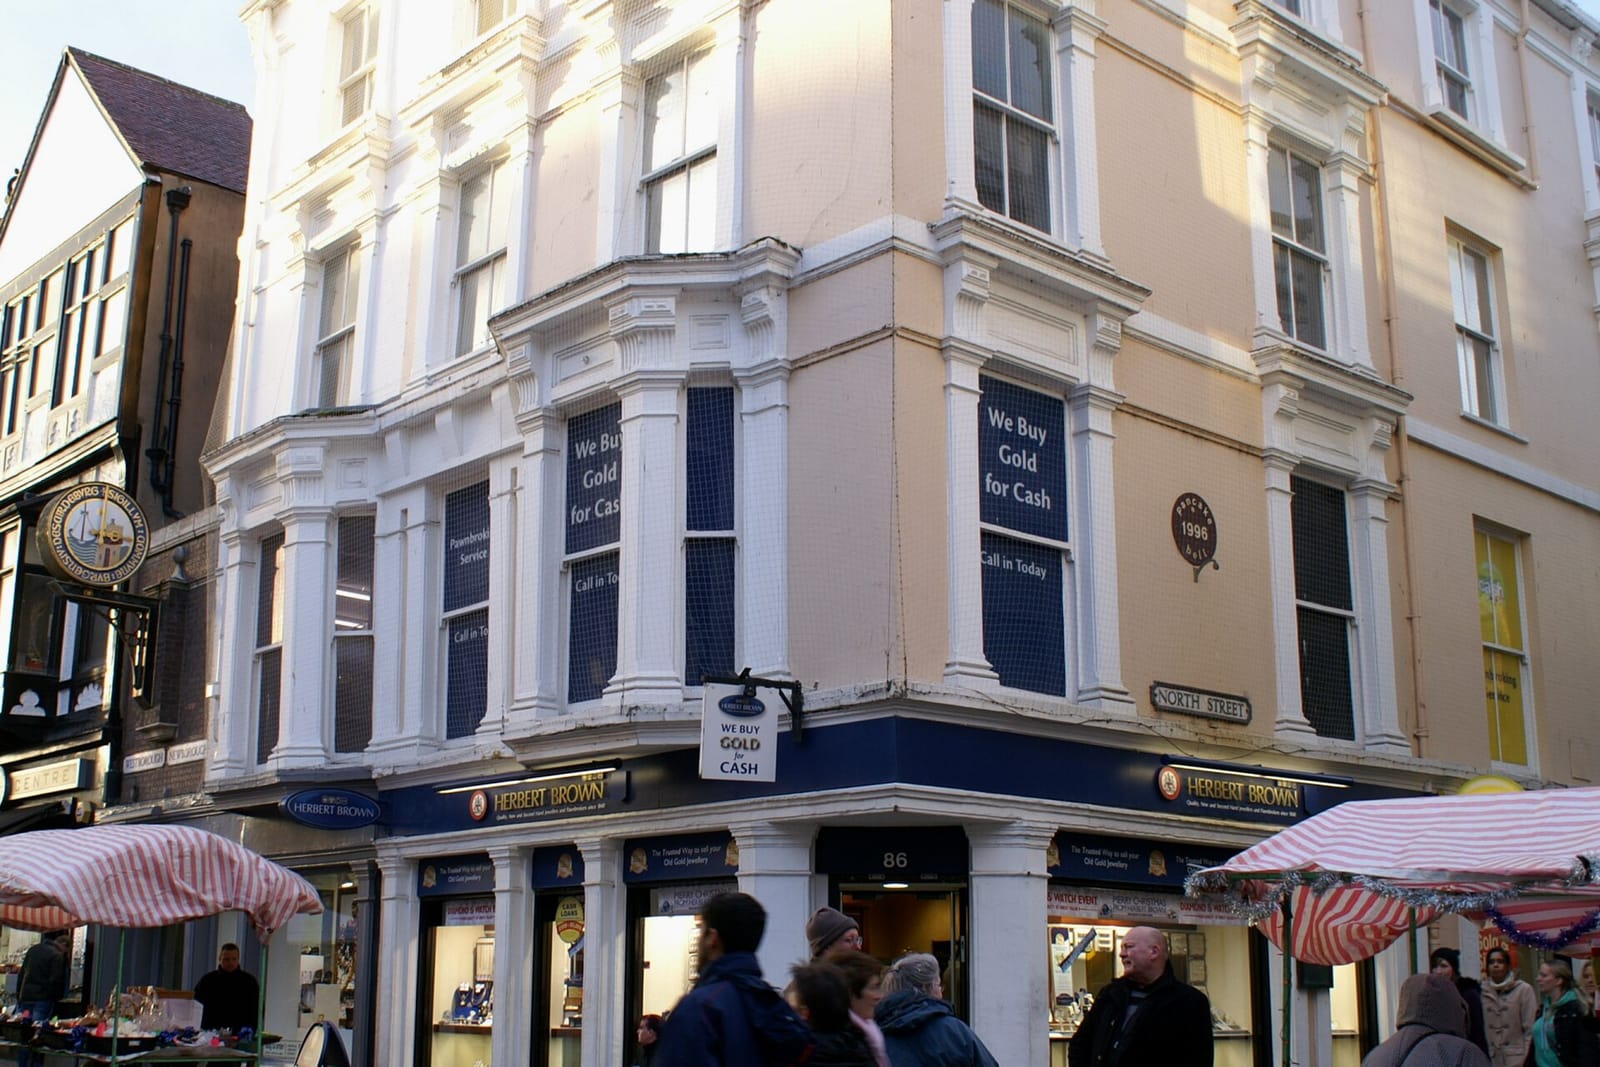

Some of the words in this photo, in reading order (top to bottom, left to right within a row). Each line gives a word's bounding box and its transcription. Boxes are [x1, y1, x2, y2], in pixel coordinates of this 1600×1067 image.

[988, 406, 1013, 432] We
[1017, 416, 1046, 446] Buy
[575, 439, 597, 460] We
[999, 444, 1037, 473] Gold
[583, 461, 617, 489] Gold
[985, 472, 1009, 497] for
[1013, 482, 1051, 510] Cash
[571, 505, 591, 525] for
[1182, 521, 1208, 541] 1996
[460, 549, 487, 565] Service
[980, 551, 1000, 568] Call
[1003, 555, 1013, 570] in
[1015, 558, 1047, 580] Today
[575, 577, 593, 593] Call
[595, 575, 604, 588] in
[454, 627, 469, 643] Call
[470, 626, 477, 639] in
[1159, 689, 1200, 710] NORTH
[1207, 698, 1245, 717] STREET
[721, 724, 737, 733] WE
[739, 724, 760, 735] BUY
[720, 736, 760, 751] GOLD
[734, 752, 745, 760] for
[720, 761, 758, 775] CASH
[15, 770, 70, 792] CENTRE
[494, 788, 546, 811] HERBERT
[551, 781, 604, 805] BROWN
[1187, 776, 1244, 801] HERBERT
[1249, 784, 1298, 808] BROWN
[294, 803, 336, 815] HERBERT
[336, 806, 374, 817] BROWN
[663, 858, 674, 866] Old
[674, 857, 686, 866] Gold
[686, 857, 708, 866] Jewellery
[883, 852, 908, 868] 86
[1084, 857, 1094, 865] Old
[1094, 858, 1107, 867] Gold
[1107, 859, 1128, 870] Jewellery
[1054, 893, 1076, 904] WATCH
[1079, 895, 1097, 905] EVENT
[1180, 902, 1206, 912] DIAMOND
[1213, 904, 1231, 913] WATC
